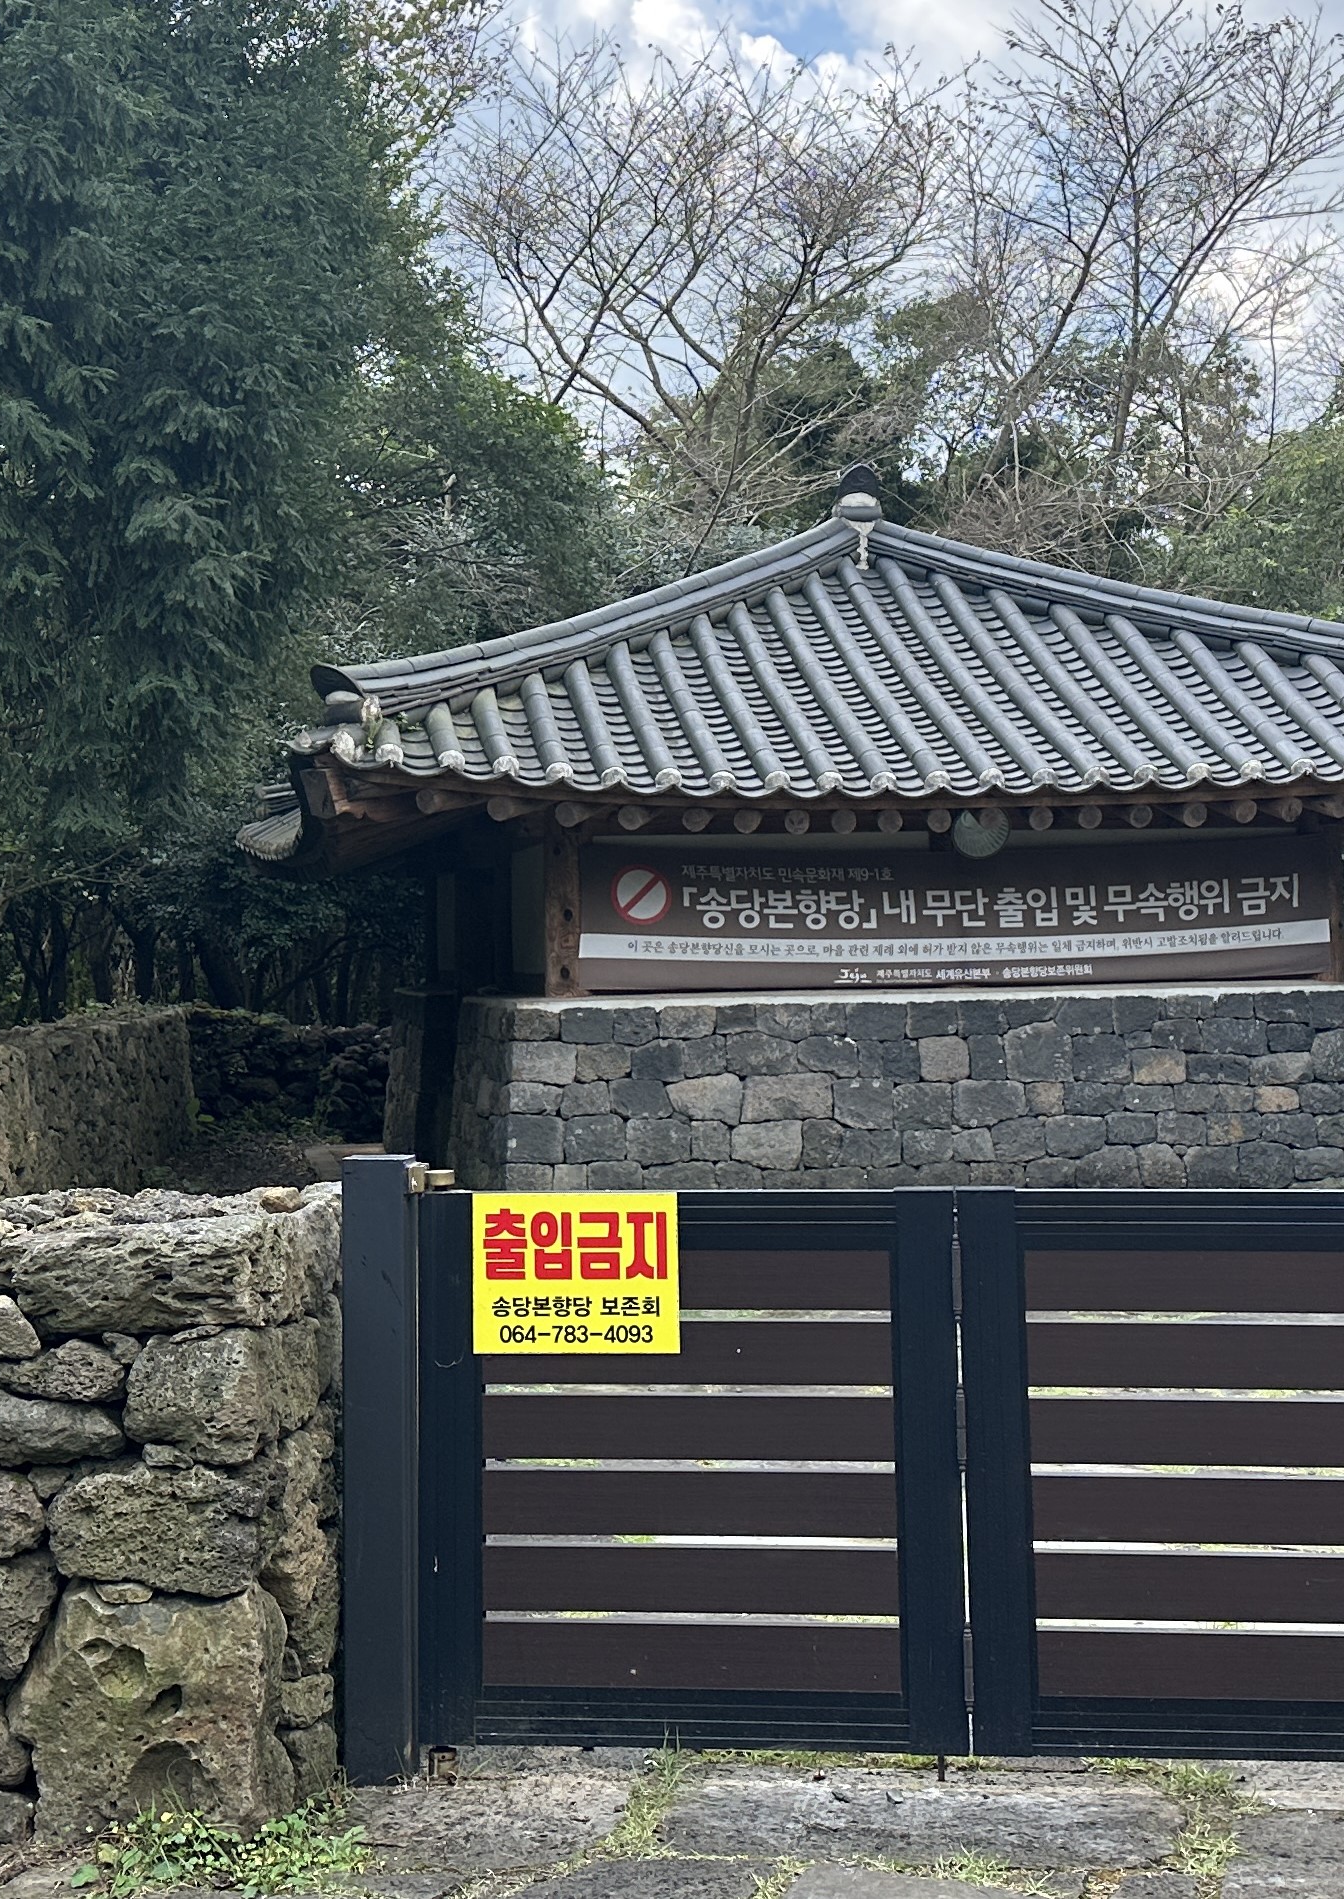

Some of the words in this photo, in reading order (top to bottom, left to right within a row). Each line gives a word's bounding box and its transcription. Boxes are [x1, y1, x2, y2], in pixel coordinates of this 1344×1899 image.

[682, 865, 777, 883] 제주특별자치도
[779, 867, 845, 883] 민속문화재
[848, 868, 895, 882] 제9-1호
[882, 889, 917, 924] 내
[922, 888, 989, 928] 무단
[993, 886, 1059, 928] 출입
[1065, 885, 1099, 926] 및
[1104, 878, 1230, 922] 무속행위
[1236, 873, 1300, 917] 금지
[627, 940, 639, 953] 이
[642, 940, 665, 953] 곳은
[667, 941, 746, 955] 송당본향당신을
[749, 942, 781, 956] 모시는
[784, 942, 820, 957] 곳으로,
[822, 942, 845, 957] 마을
[848, 942, 870, 957] 관련
[897, 942, 919, 957] 외에
[921, 942, 944, 956] 허가
[946, 942, 968, 956] 받지
[971, 942, 993, 956] 않은
[995, 941, 1048, 955] 무속행위는
[1051, 939, 1072, 953] 일체
[1075, 938, 1120, 954] 금지하며,
[1121, 935, 1153, 950] 위반시
[1157, 932, 1218, 949] 고발조치됨을
[876, 968, 933, 979] 제주특별자치도
[936, 967, 992, 980] 세계유산본부
[1002, 964, 1094, 978] 송당본향당보존위원회
[483, 1208, 669, 1280] 출입금지
[492, 1296, 593, 1317] 송당본향당
[600, 1296, 660, 1317] 보존회
[499, 1325, 654, 1344] 064-783-4093
